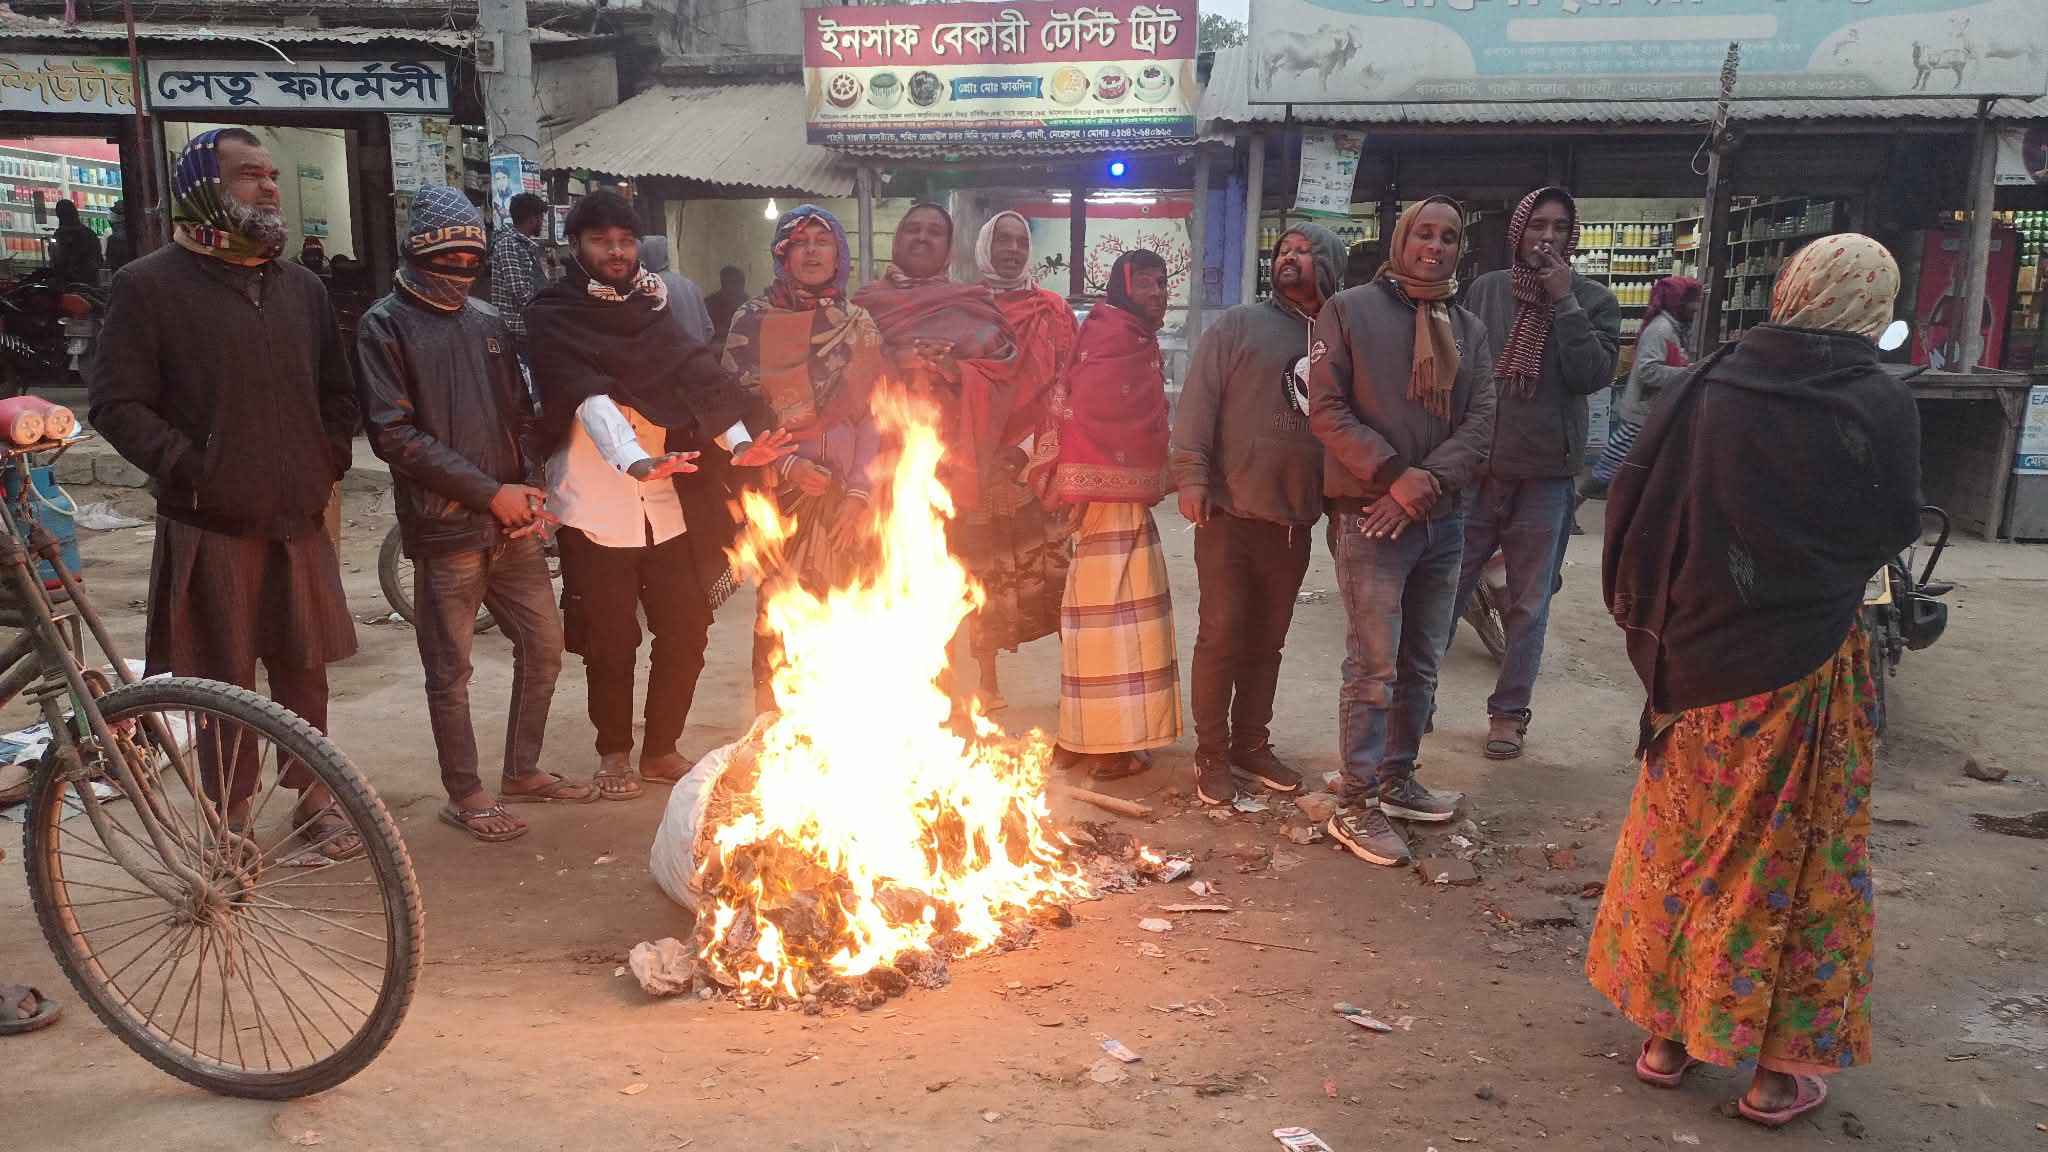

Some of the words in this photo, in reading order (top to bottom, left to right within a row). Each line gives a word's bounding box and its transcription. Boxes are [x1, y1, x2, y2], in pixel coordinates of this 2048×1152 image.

[817, 17, 920, 61] ইনসাফ
[931, 8, 1032, 56] বেকারী
[1040, 7, 1124, 53] টেস্টি
[1128, 5, 1181, 54] ট্রিট
[0, 58, 135, 107] ম্পিউটার
[157, 71, 261, 105] সেতু
[264, 62, 443, 102] ফার্মেসী
